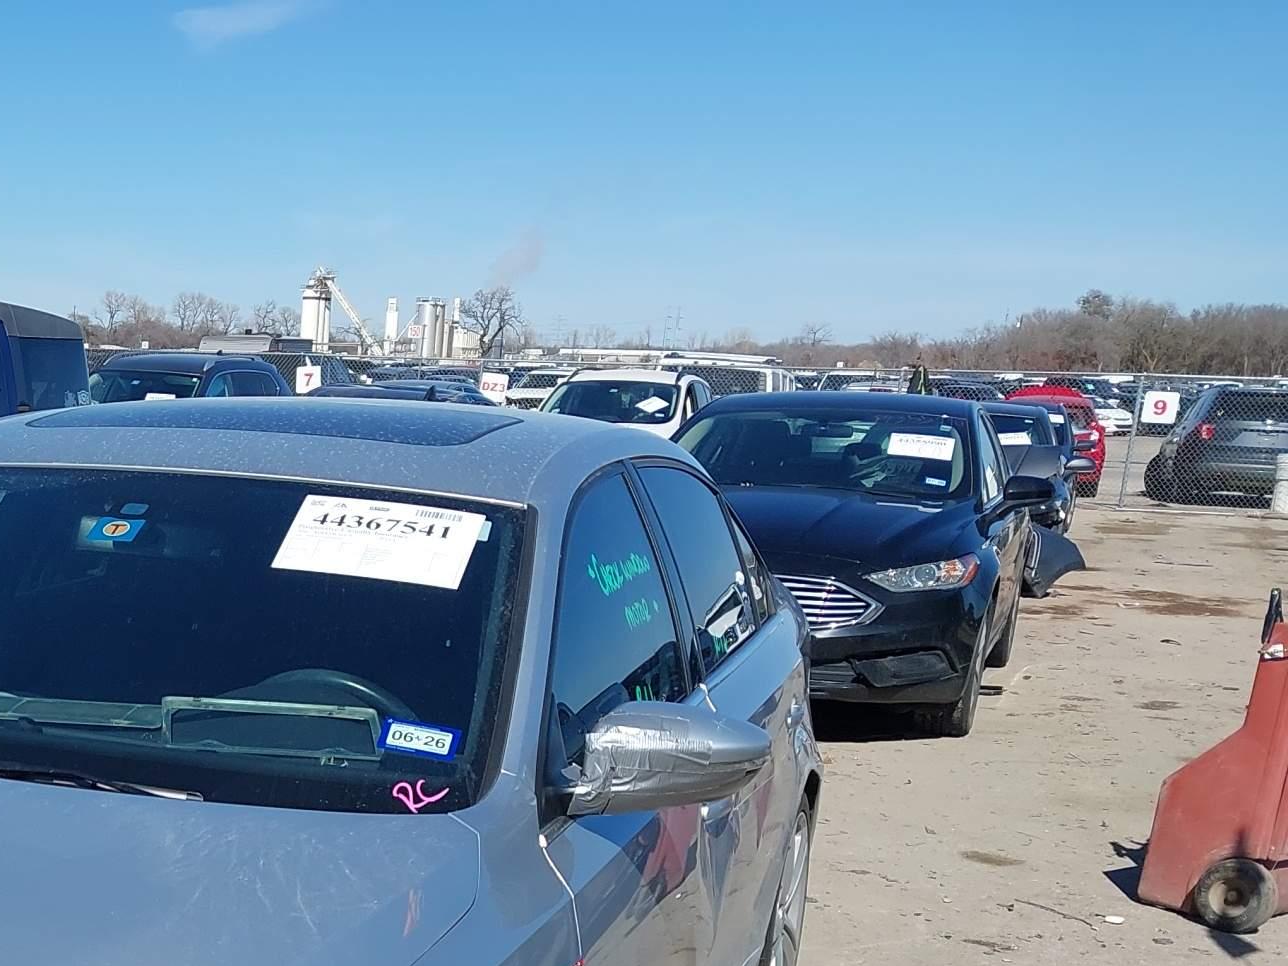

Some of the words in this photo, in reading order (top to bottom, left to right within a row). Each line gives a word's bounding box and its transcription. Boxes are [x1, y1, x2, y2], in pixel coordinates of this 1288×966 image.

[303, 372, 314, 386] 7
[482, 382, 506, 393] DZ3
[1153, 399, 1168, 416] 9
[313, 512, 451, 539] 44367541
